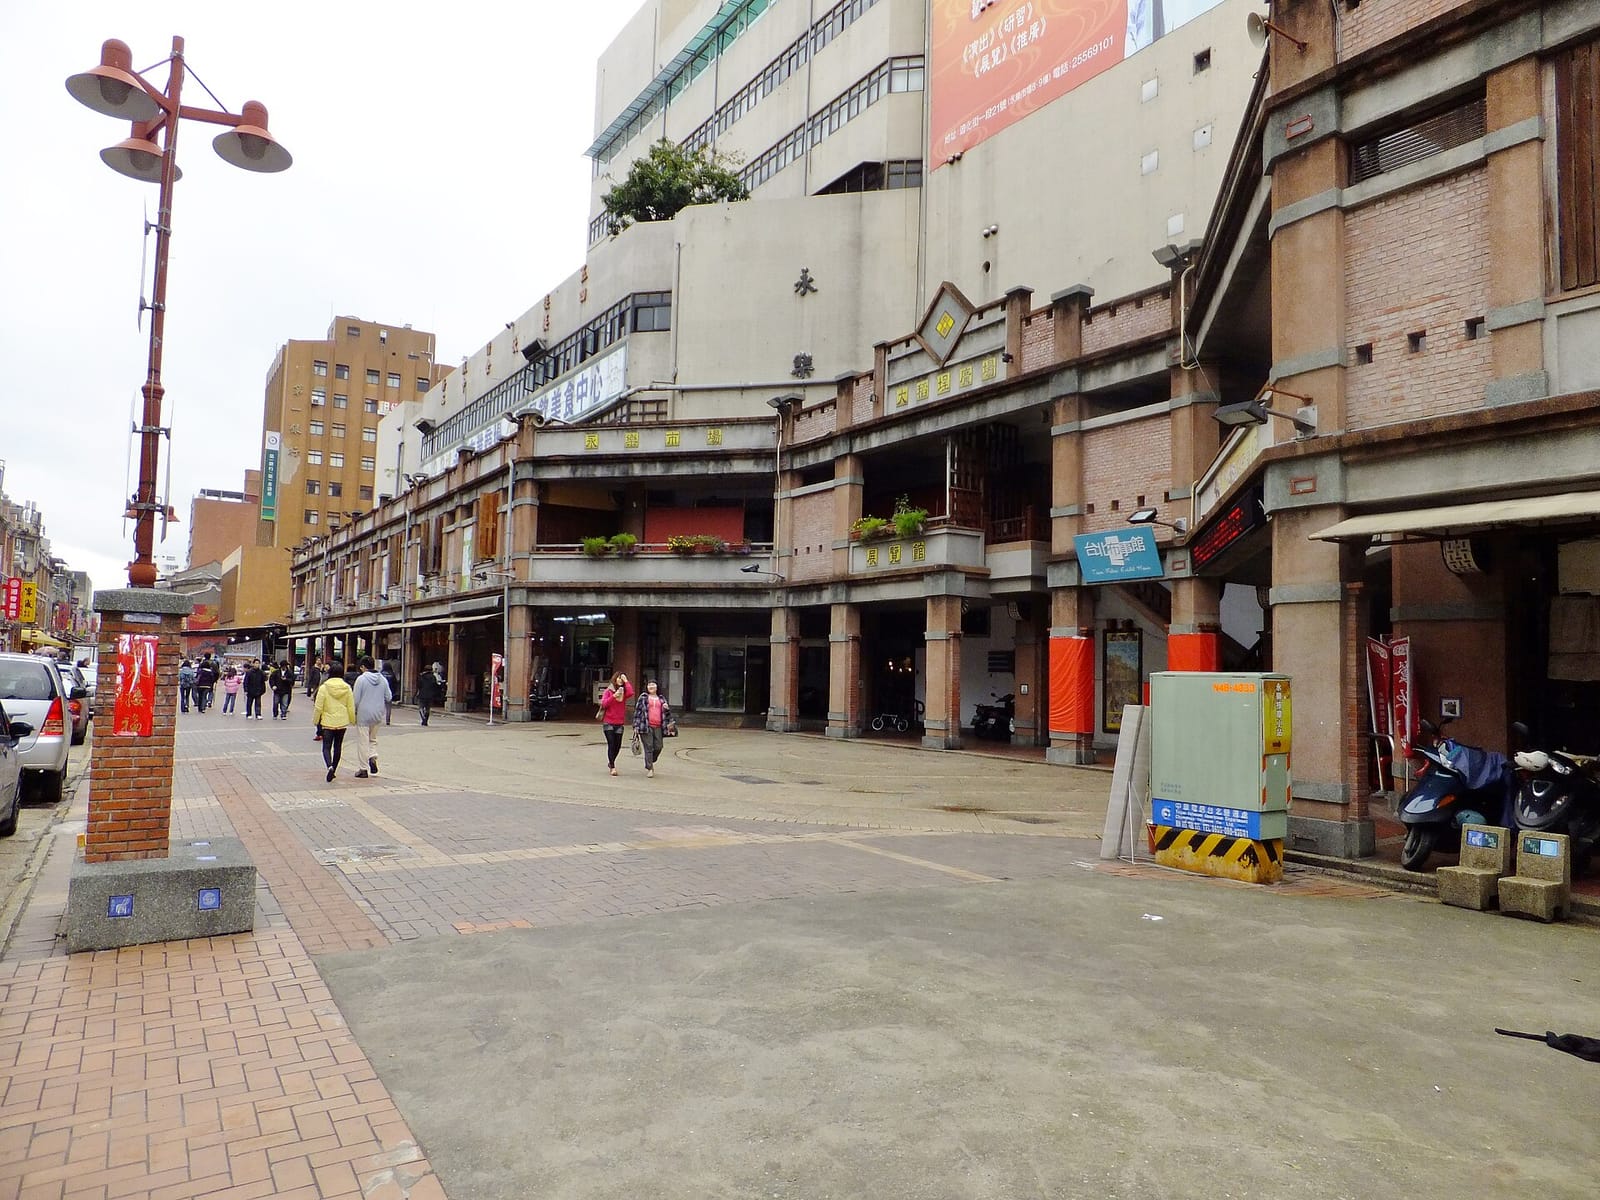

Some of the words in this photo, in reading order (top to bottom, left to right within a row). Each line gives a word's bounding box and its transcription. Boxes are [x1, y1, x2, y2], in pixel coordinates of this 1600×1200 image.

[896, 357, 996, 407] 大稻埕廣場
[585, 428, 722, 450] 永樂市場
[866, 542, 926, 567] 展覽館
